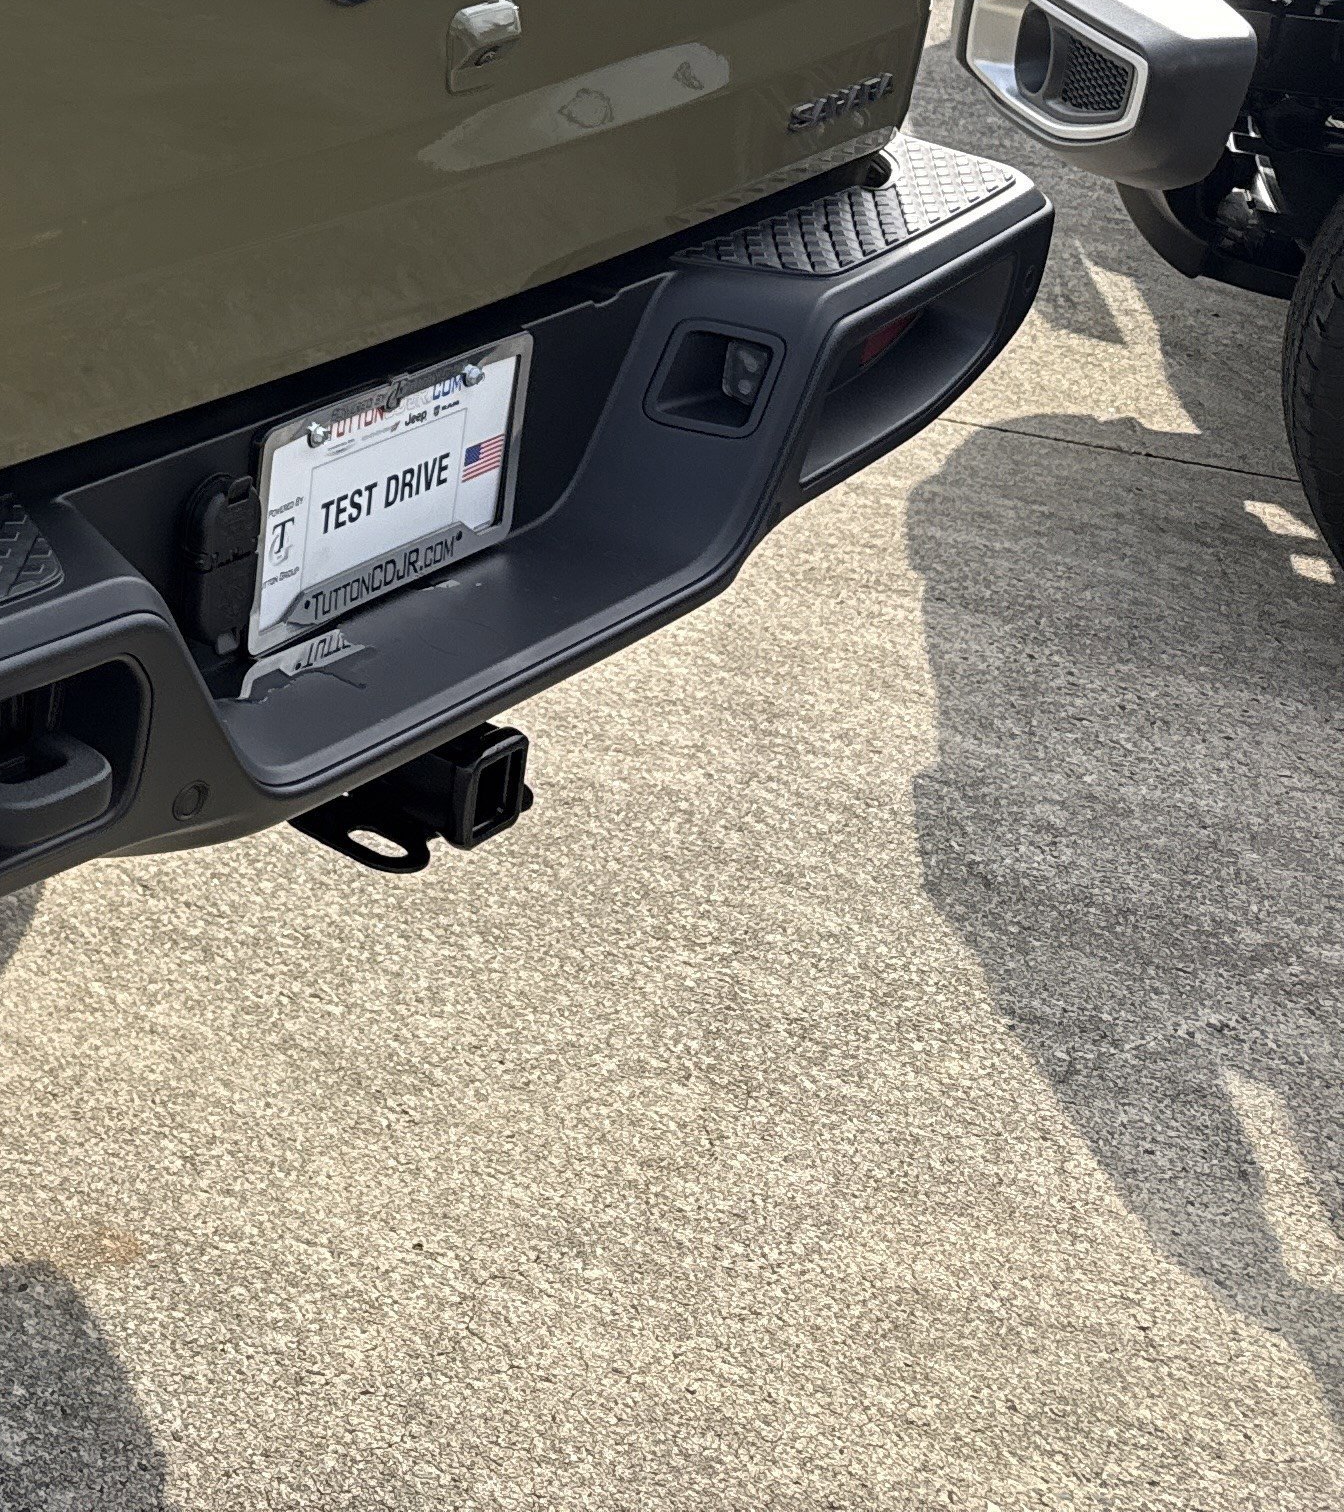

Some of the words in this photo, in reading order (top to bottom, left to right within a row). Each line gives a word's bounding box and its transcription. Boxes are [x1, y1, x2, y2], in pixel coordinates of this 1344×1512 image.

[404, 410, 428, 427] Jeep
[321, 482, 378, 535] TEST
[383, 451, 452, 509] DRIVE
[312, 535, 456, 621] TUTTONCDJR.COM
